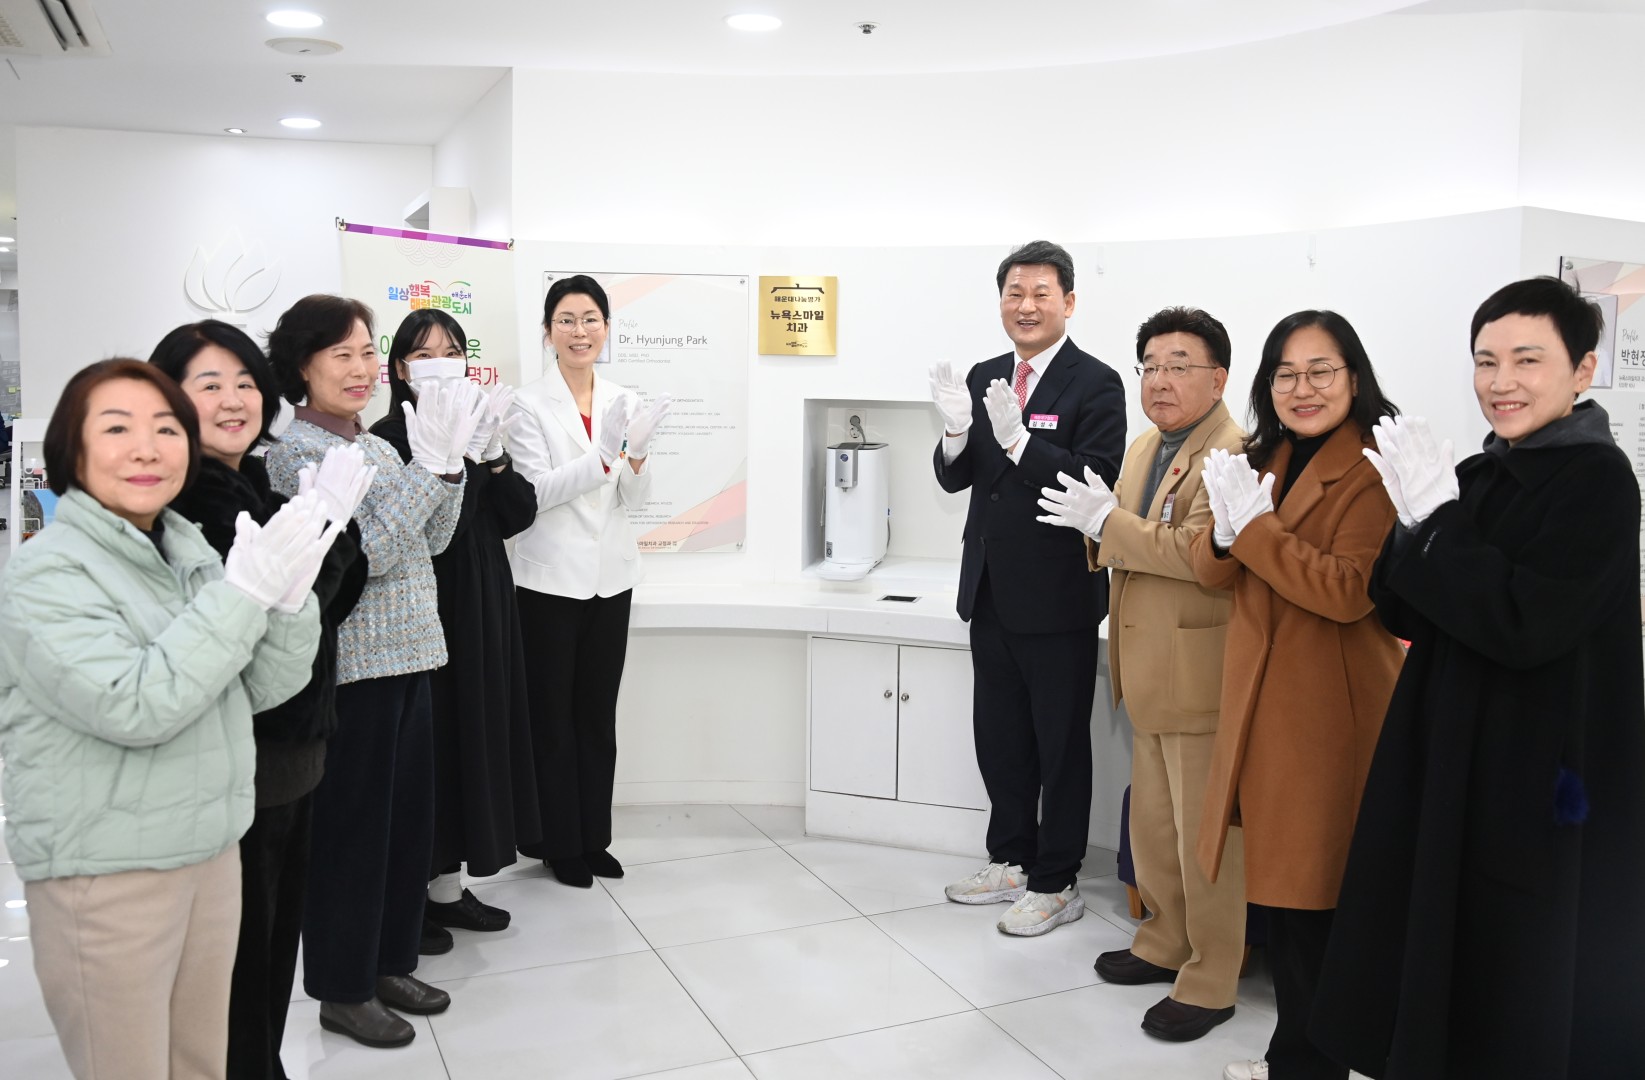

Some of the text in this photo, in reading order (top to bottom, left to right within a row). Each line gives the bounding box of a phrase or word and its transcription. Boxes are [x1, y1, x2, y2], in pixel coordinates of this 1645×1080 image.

[770, 310, 824, 321] 뉴욕스마일
[786, 322, 808, 333] 치과
[618, 334, 708, 348] Dr. Hyunjung Park
[467, 366, 499, 386] 명가
